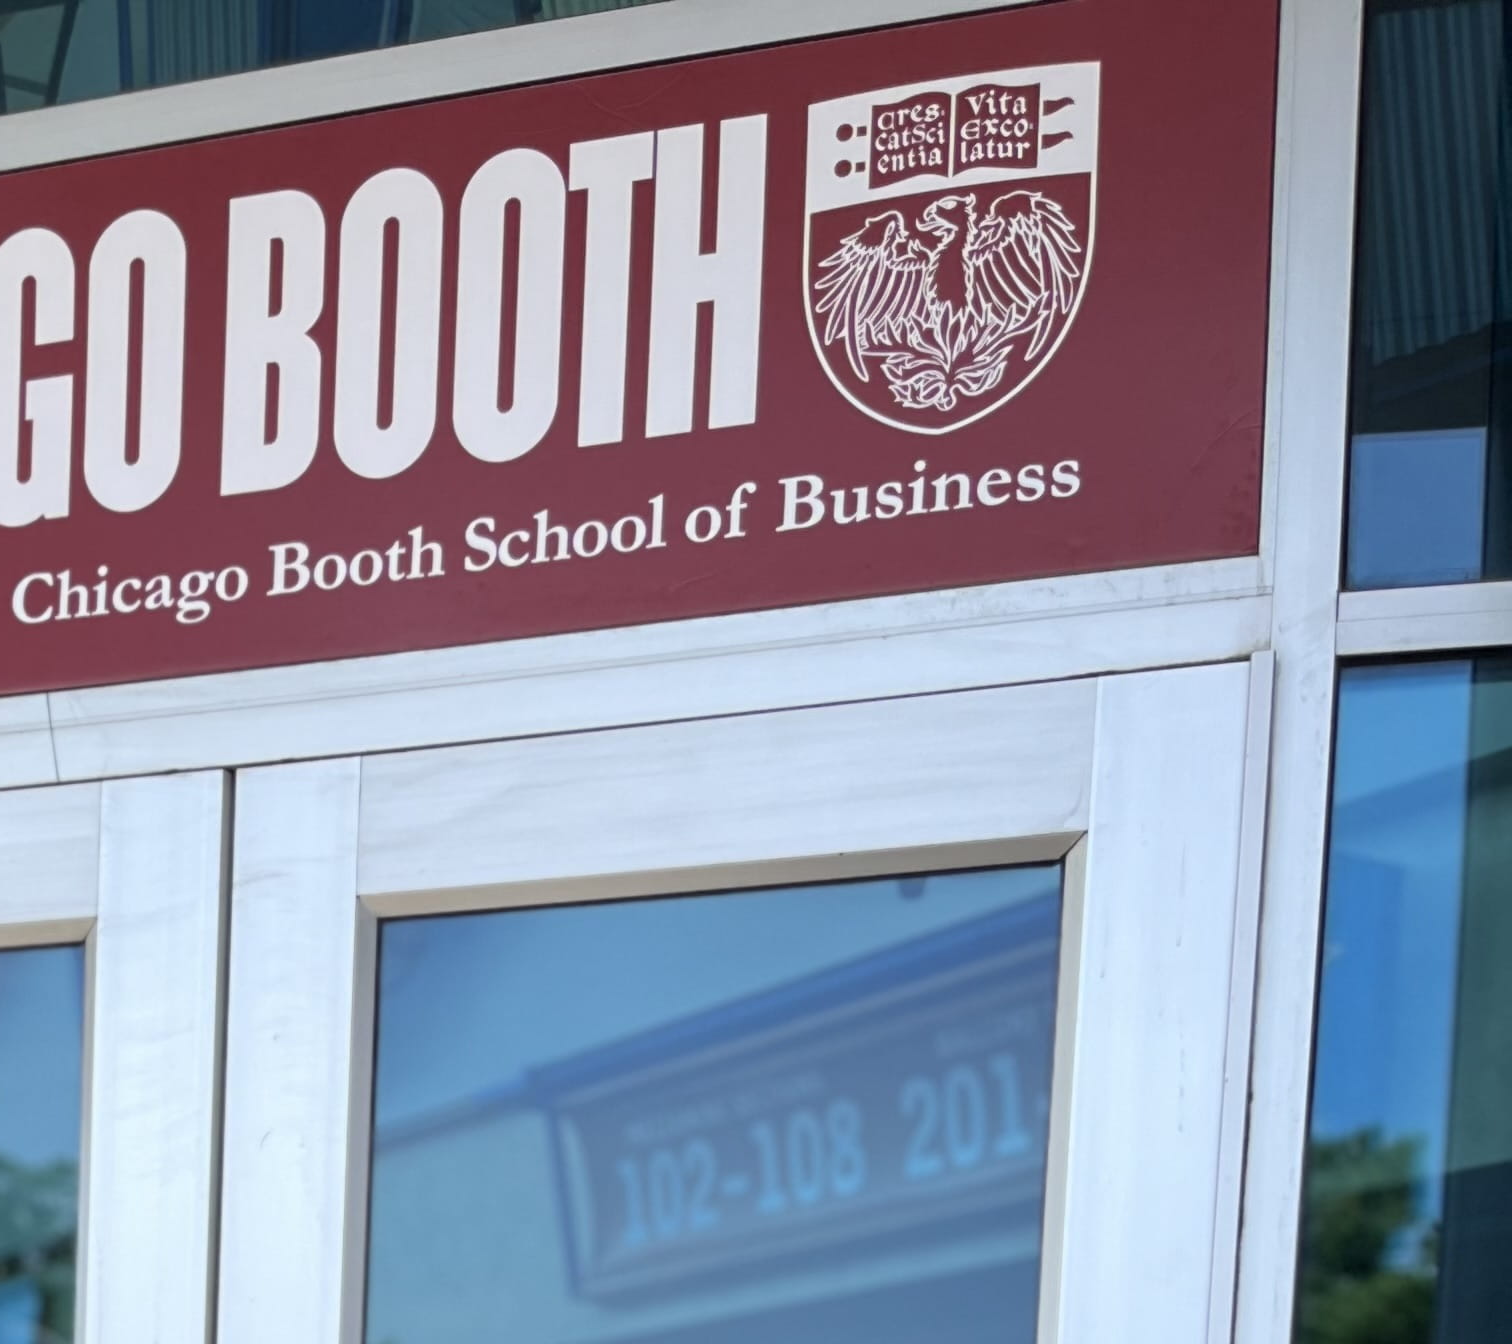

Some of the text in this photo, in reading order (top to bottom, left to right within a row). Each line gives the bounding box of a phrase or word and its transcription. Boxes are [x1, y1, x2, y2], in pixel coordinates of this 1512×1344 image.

[964, 89, 1027, 116] Vita
[876, 146, 943, 174] entia
[960, 138, 1031, 164] latur
[219, 113, 768, 497] BOOTH
[12, 565, 249, 624] Chicago
[266, 525, 446, 596] Booth
[452, 493, 667, 572] School
[684, 481, 757, 543] of
[775, 459, 1081, 532] Business
[618, 1099, 866, 1247] 102-108
